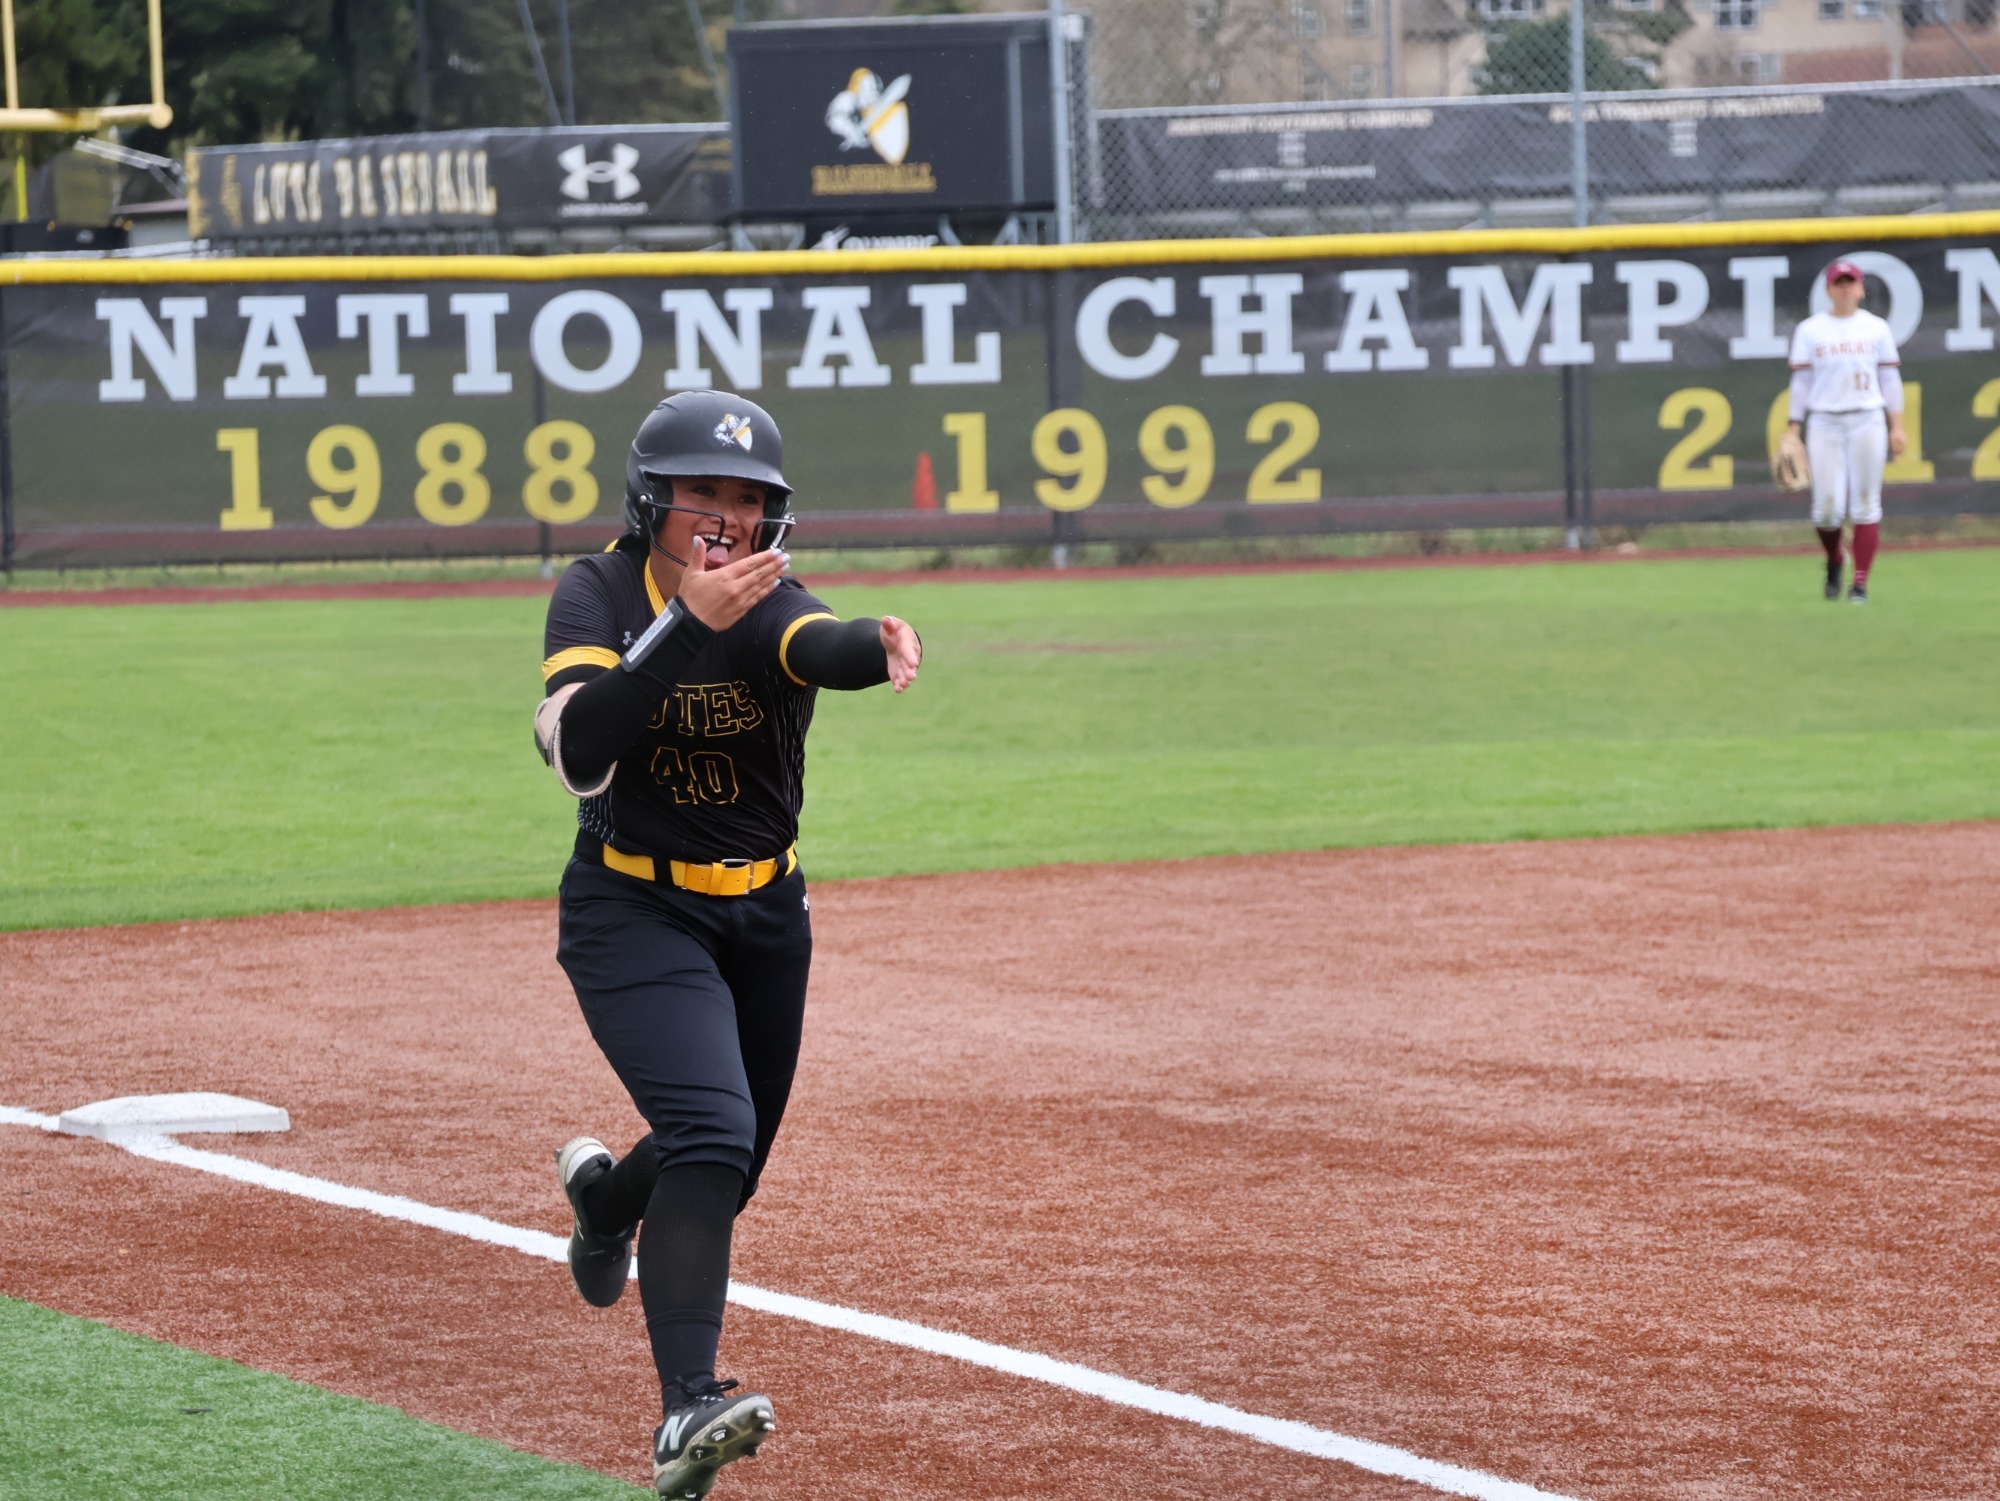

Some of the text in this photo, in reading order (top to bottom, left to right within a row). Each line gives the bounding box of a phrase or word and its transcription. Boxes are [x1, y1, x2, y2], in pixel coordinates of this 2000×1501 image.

[95, 283, 1001, 401] NATIONAL
[216, 419, 599, 531] 1988
[944, 402, 1322, 513] 1992
[650, 746, 740, 806] 40
